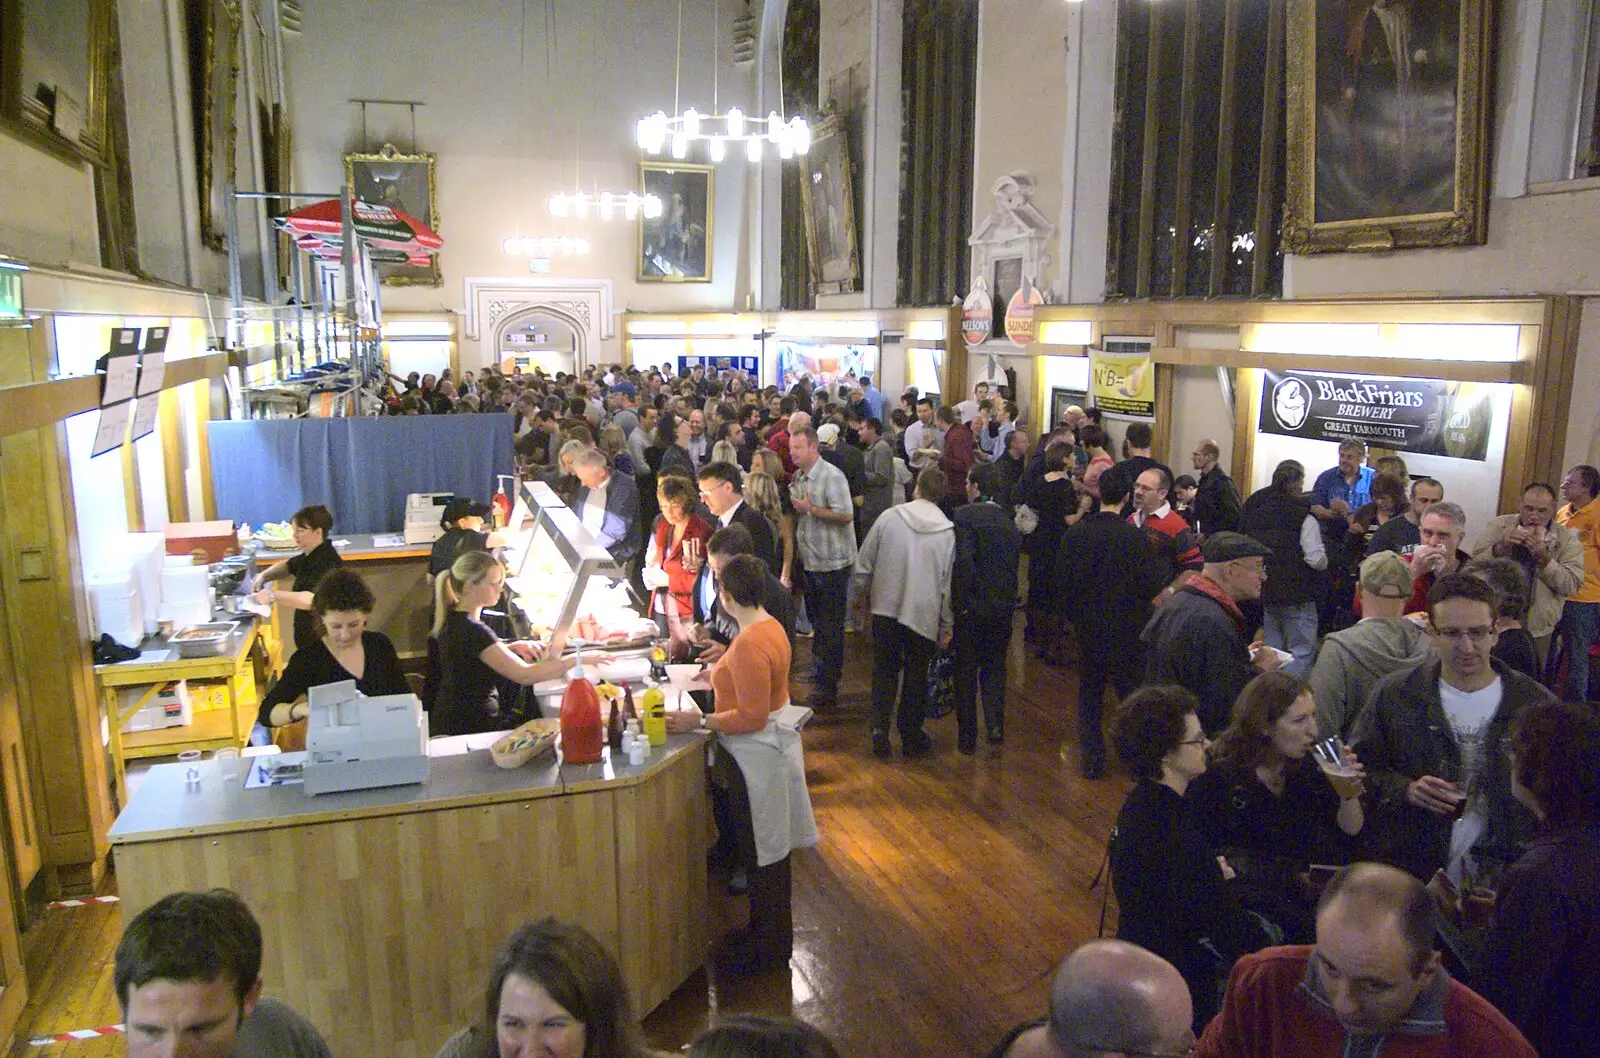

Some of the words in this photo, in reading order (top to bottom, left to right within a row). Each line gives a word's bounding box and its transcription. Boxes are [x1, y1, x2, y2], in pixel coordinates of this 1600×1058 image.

[1008, 320, 1034, 333] SUNDE
[1316, 379, 1423, 407] BlackFriars
[1336, 404, 1396, 420] BREWERY
[1324, 421, 1351, 433] GREAT
[1353, 424, 1405, 438] YARMOUTH
